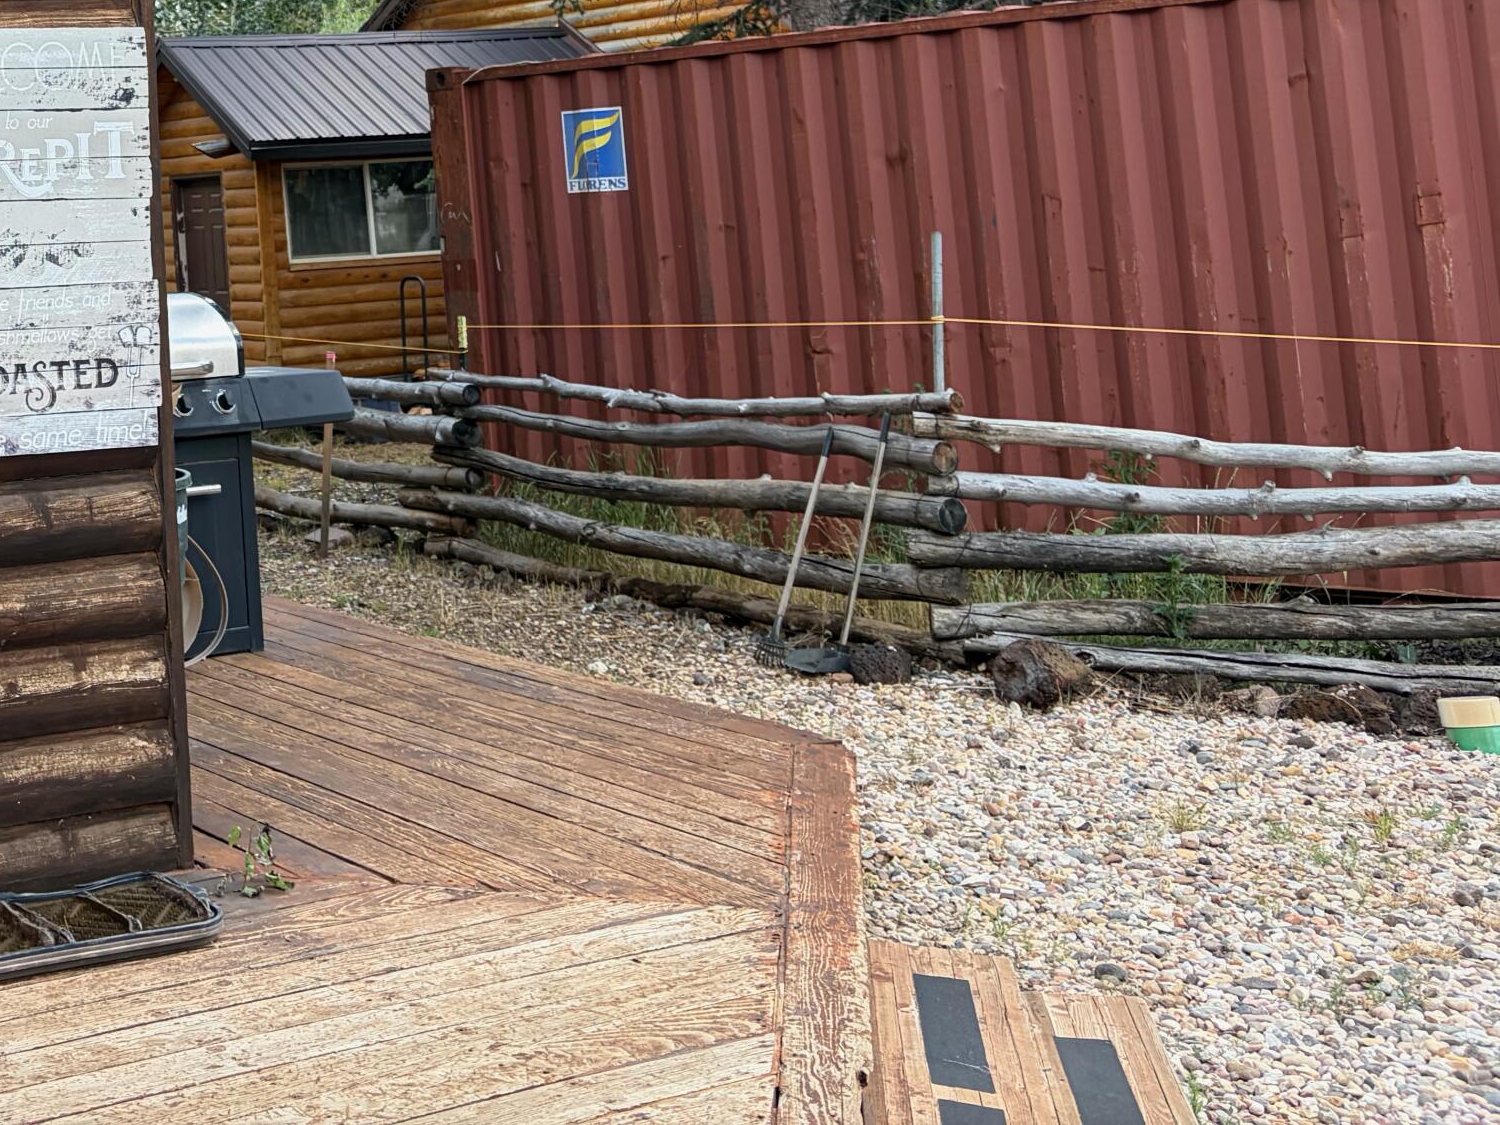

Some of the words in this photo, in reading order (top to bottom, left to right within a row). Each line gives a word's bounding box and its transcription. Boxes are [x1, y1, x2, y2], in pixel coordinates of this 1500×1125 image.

[5, 111, 20, 130] to
[27, 116, 53, 129] our
[18, 279, 73, 323] friends
[82, 277, 112, 306] and
[20, 429, 83, 450] same
[91, 411, 148, 446] time!
